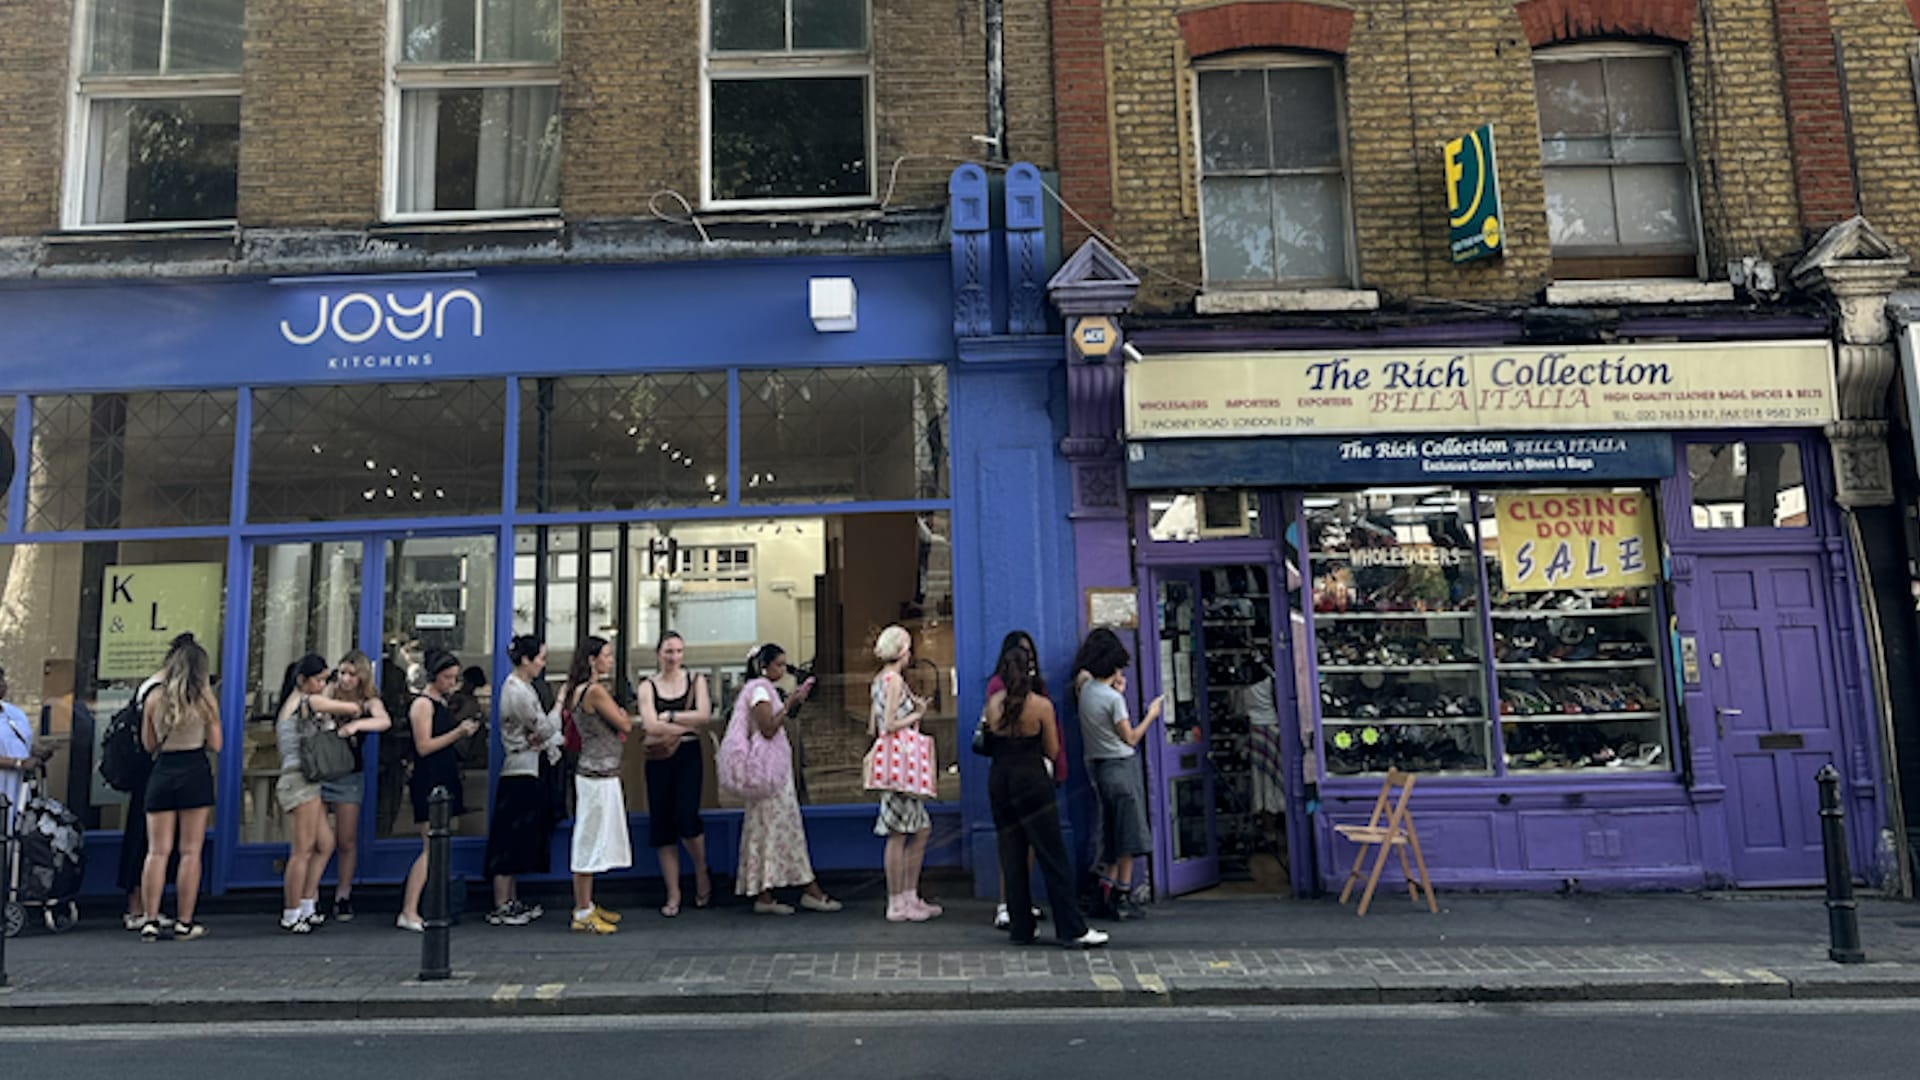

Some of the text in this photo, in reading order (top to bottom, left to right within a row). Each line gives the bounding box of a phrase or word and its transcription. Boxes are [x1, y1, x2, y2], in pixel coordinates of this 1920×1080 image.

[328, 353, 433, 369] KITCHENS
[1306, 352, 1674, 390] The Rich Collection
[1138, 396, 1353, 411] WHOLESALERS IMPORTERS EXPORTERS
[1368, 387, 1591, 413] BELLA ITALIA
[1603, 392, 1629, 402] HIGH
[1632, 391, 1671, 401] QUALITY
[1676, 390, 1716, 401] LEATHER
[1751, 388, 1783, 400] SHOES
[1787, 388, 1794, 399] &
[1797, 388, 1823, 399] BELTS
[1151, 418, 1197, 430] HACKNEY
[1199, 417, 1229, 429] ROAD
[1232, 416, 1278, 428] LONDON
[1340, 436, 1627, 460] The Rich Collection BELLA ITALIA
[1524, 457, 1556, 471] Shoes
[1557, 456, 1566, 470] &
[1567, 456, 1595, 472] Bags
[1508, 497, 1638, 521] CLOSING
[1536, 519, 1616, 539] DOWN
[1349, 546, 1461, 568] WHOLESALERS
[1515, 536, 1646, 584] SALE
[111, 573, 135, 604] K
[109, 616, 125, 634] &
[150, 601, 168, 631] L
